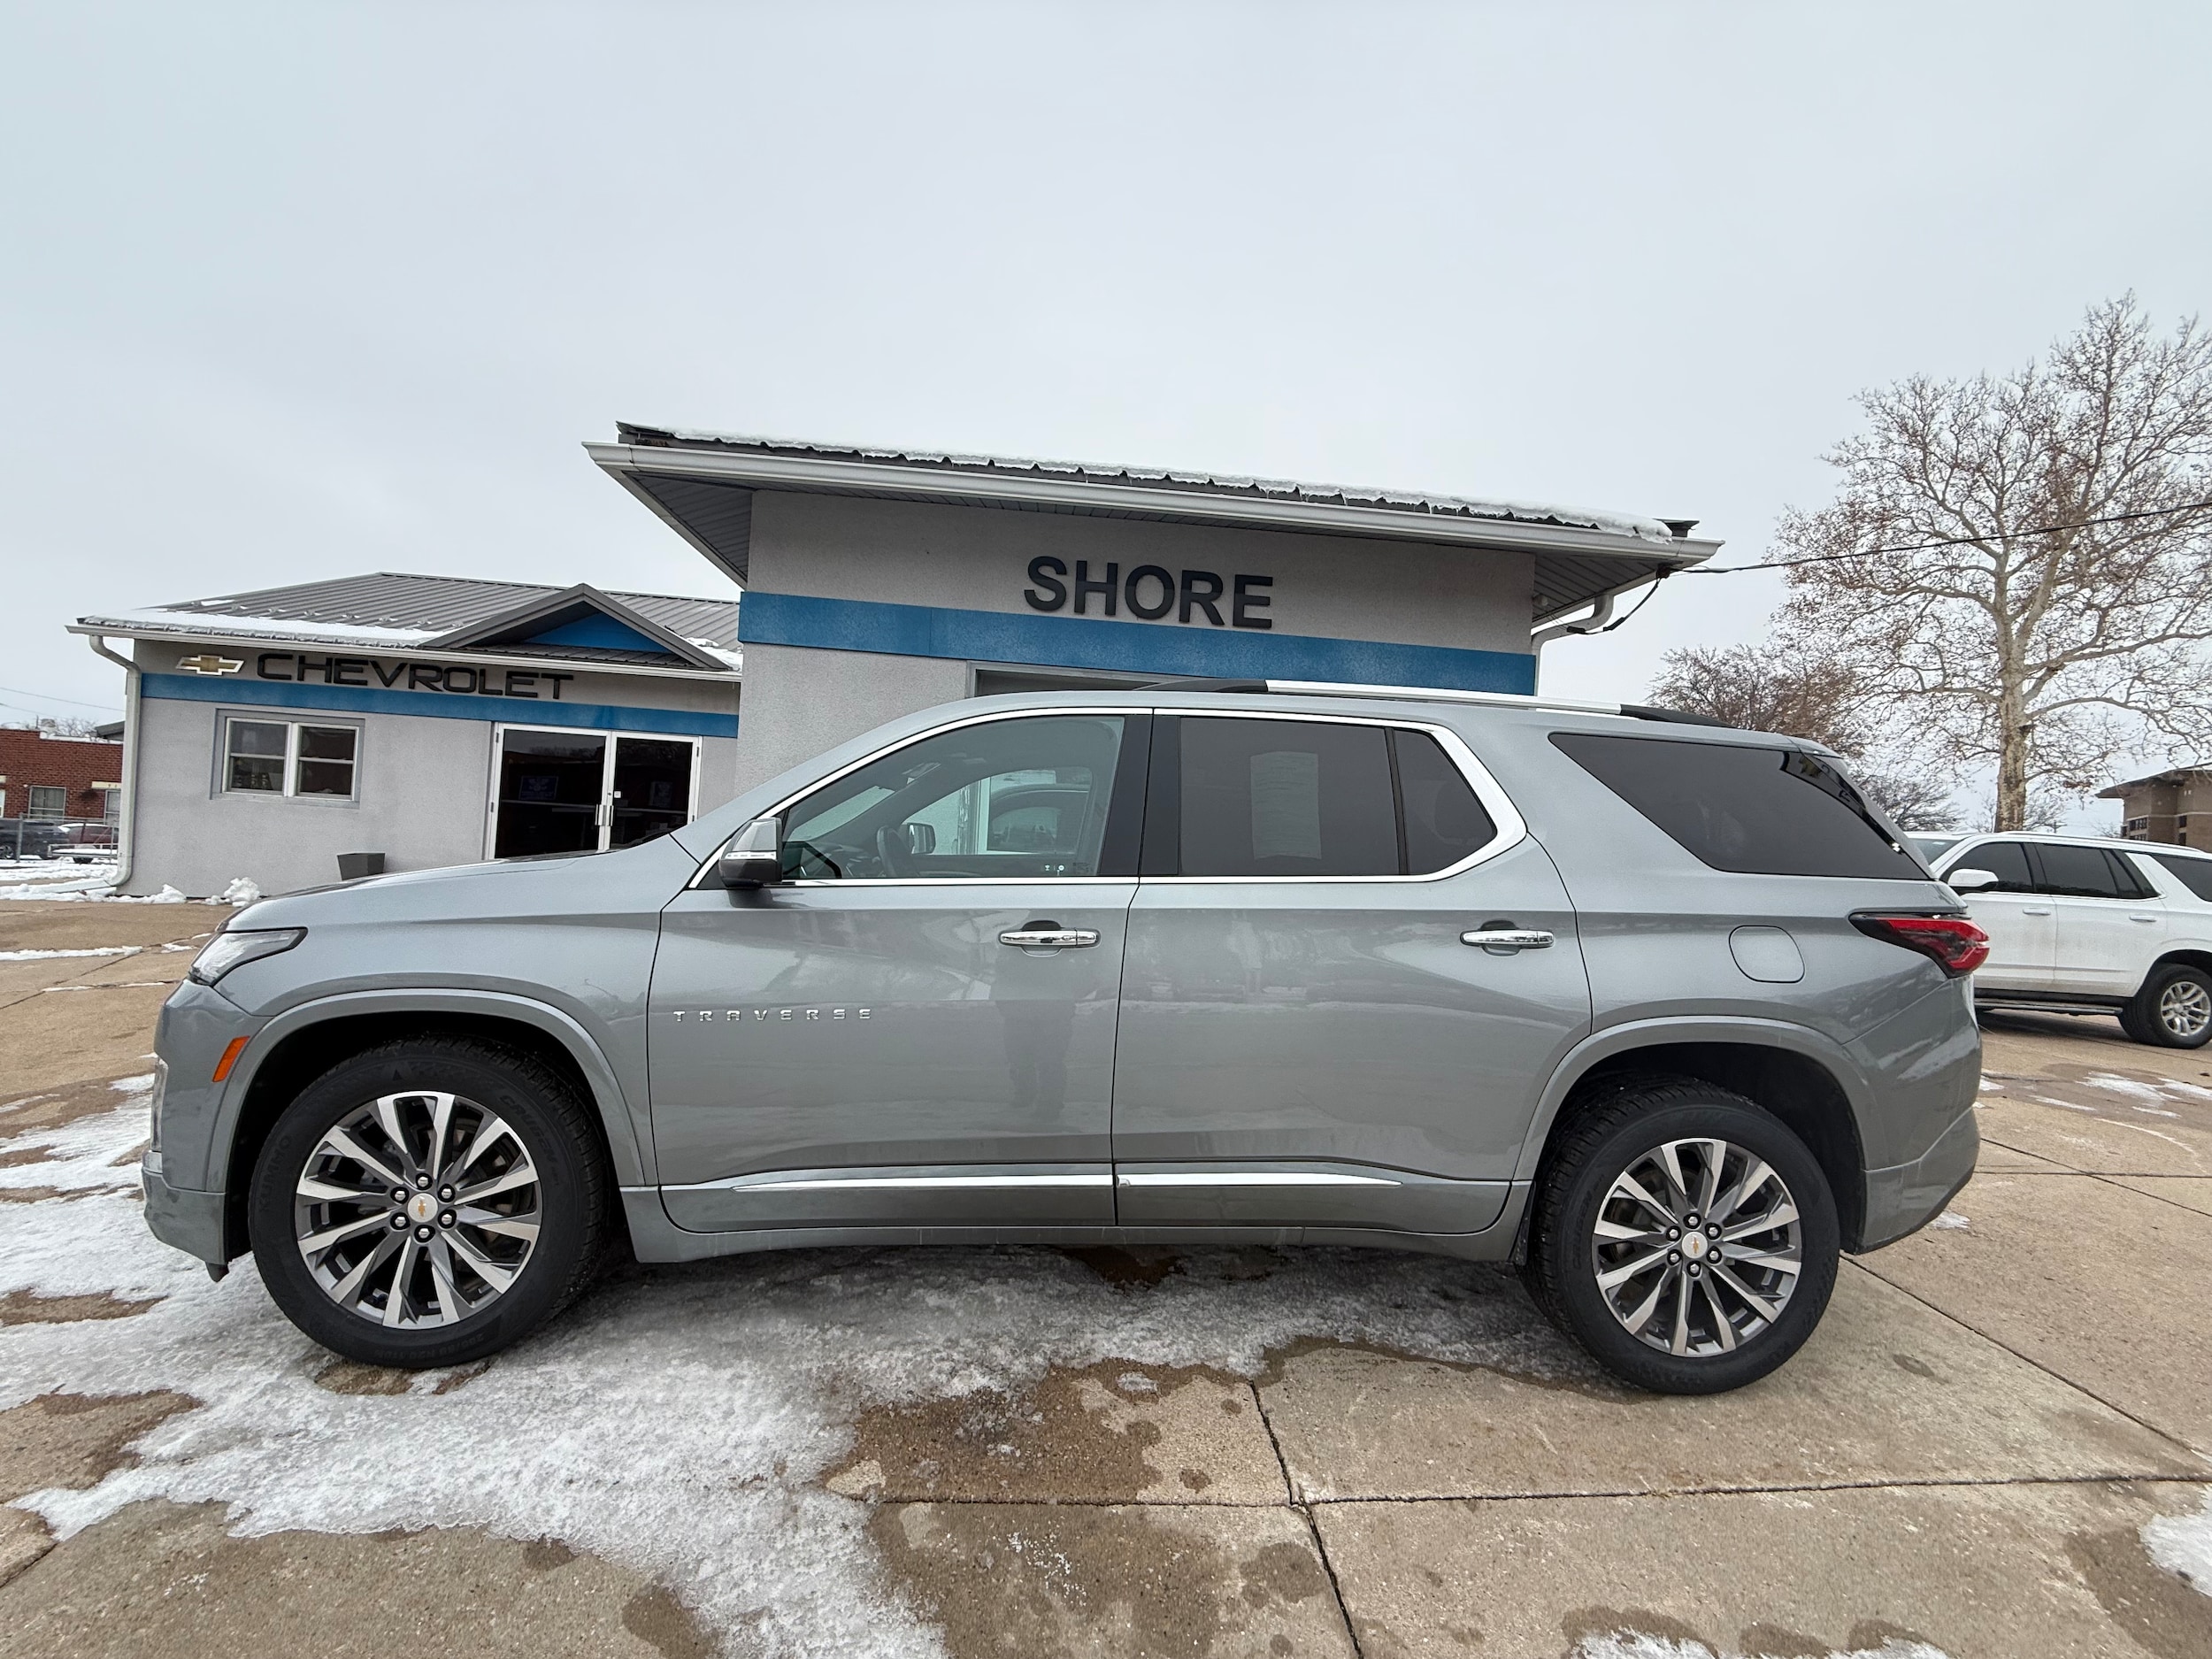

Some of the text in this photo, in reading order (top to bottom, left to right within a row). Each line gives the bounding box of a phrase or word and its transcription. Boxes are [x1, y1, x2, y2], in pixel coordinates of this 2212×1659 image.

[1024, 556, 1273, 628] SHORE
[257, 653, 574, 700] CHEVROLET
[672, 1008, 872, 1023] TRAVERSE
